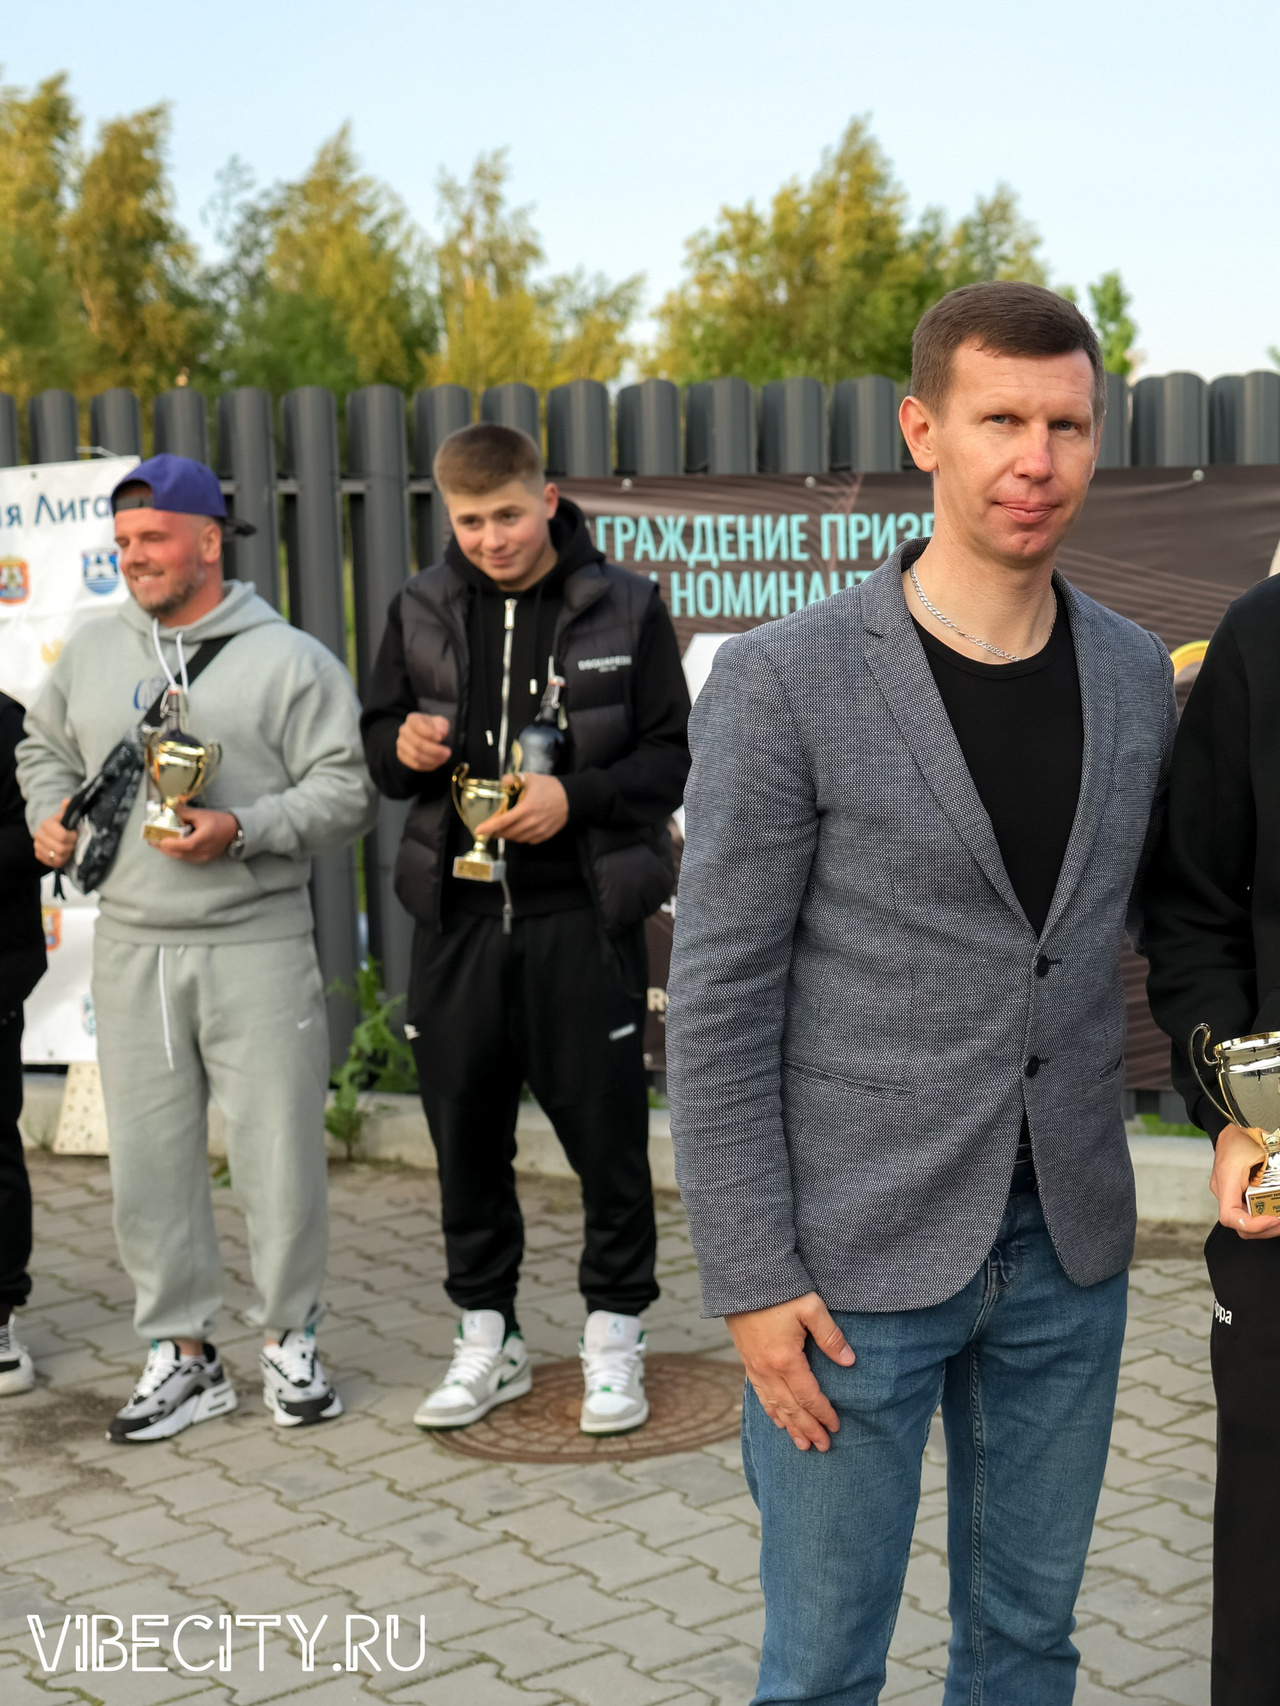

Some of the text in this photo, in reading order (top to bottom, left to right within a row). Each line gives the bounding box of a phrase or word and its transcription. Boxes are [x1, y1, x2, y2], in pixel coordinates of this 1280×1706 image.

[33, 493, 113, 526] Лига
[585, 513, 811, 569] ГРАЖДЕНИЕ
[670, 569, 874, 618] НОМИНА
